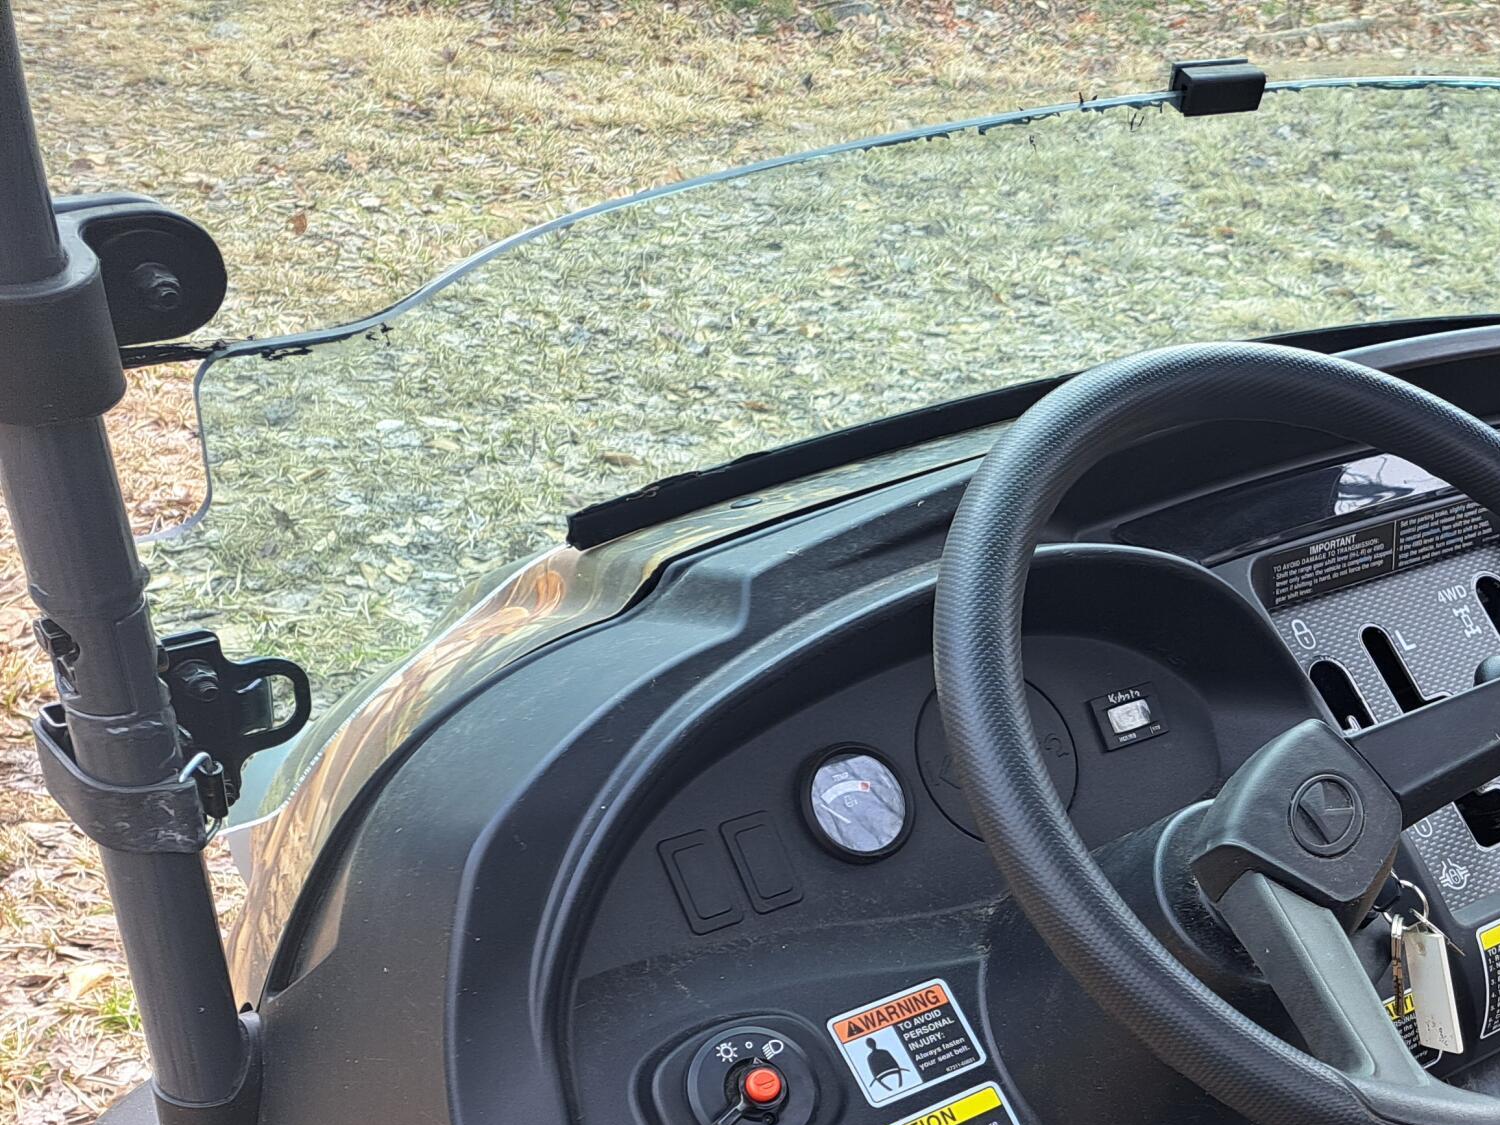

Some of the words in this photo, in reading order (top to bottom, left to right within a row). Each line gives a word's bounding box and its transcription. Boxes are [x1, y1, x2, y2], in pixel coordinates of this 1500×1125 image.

[1309, 533, 1357, 555] IMPORTANT
[1282, 560, 1300, 569] AVOID
[1301, 552, 1326, 564] DAMAGE
[1436, 584, 1468, 604] 4WD
[1395, 630, 1416, 651] L
[1487, 947, 1496, 956] TO
[859, 990, 939, 1029] WARNING
[897, 1020, 911, 1030] TO
[913, 1009, 941, 1025] AVOID
[903, 1017, 953, 1040] PERSONAL
[908, 1032, 944, 1050] INJURY:
[915, 1047, 941, 1060] Always
[942, 1037, 964, 1049] fasten
[919, 1059, 935, 1070] your
[937, 1051, 953, 1061] seat
[953, 1045, 969, 1054] belt.
